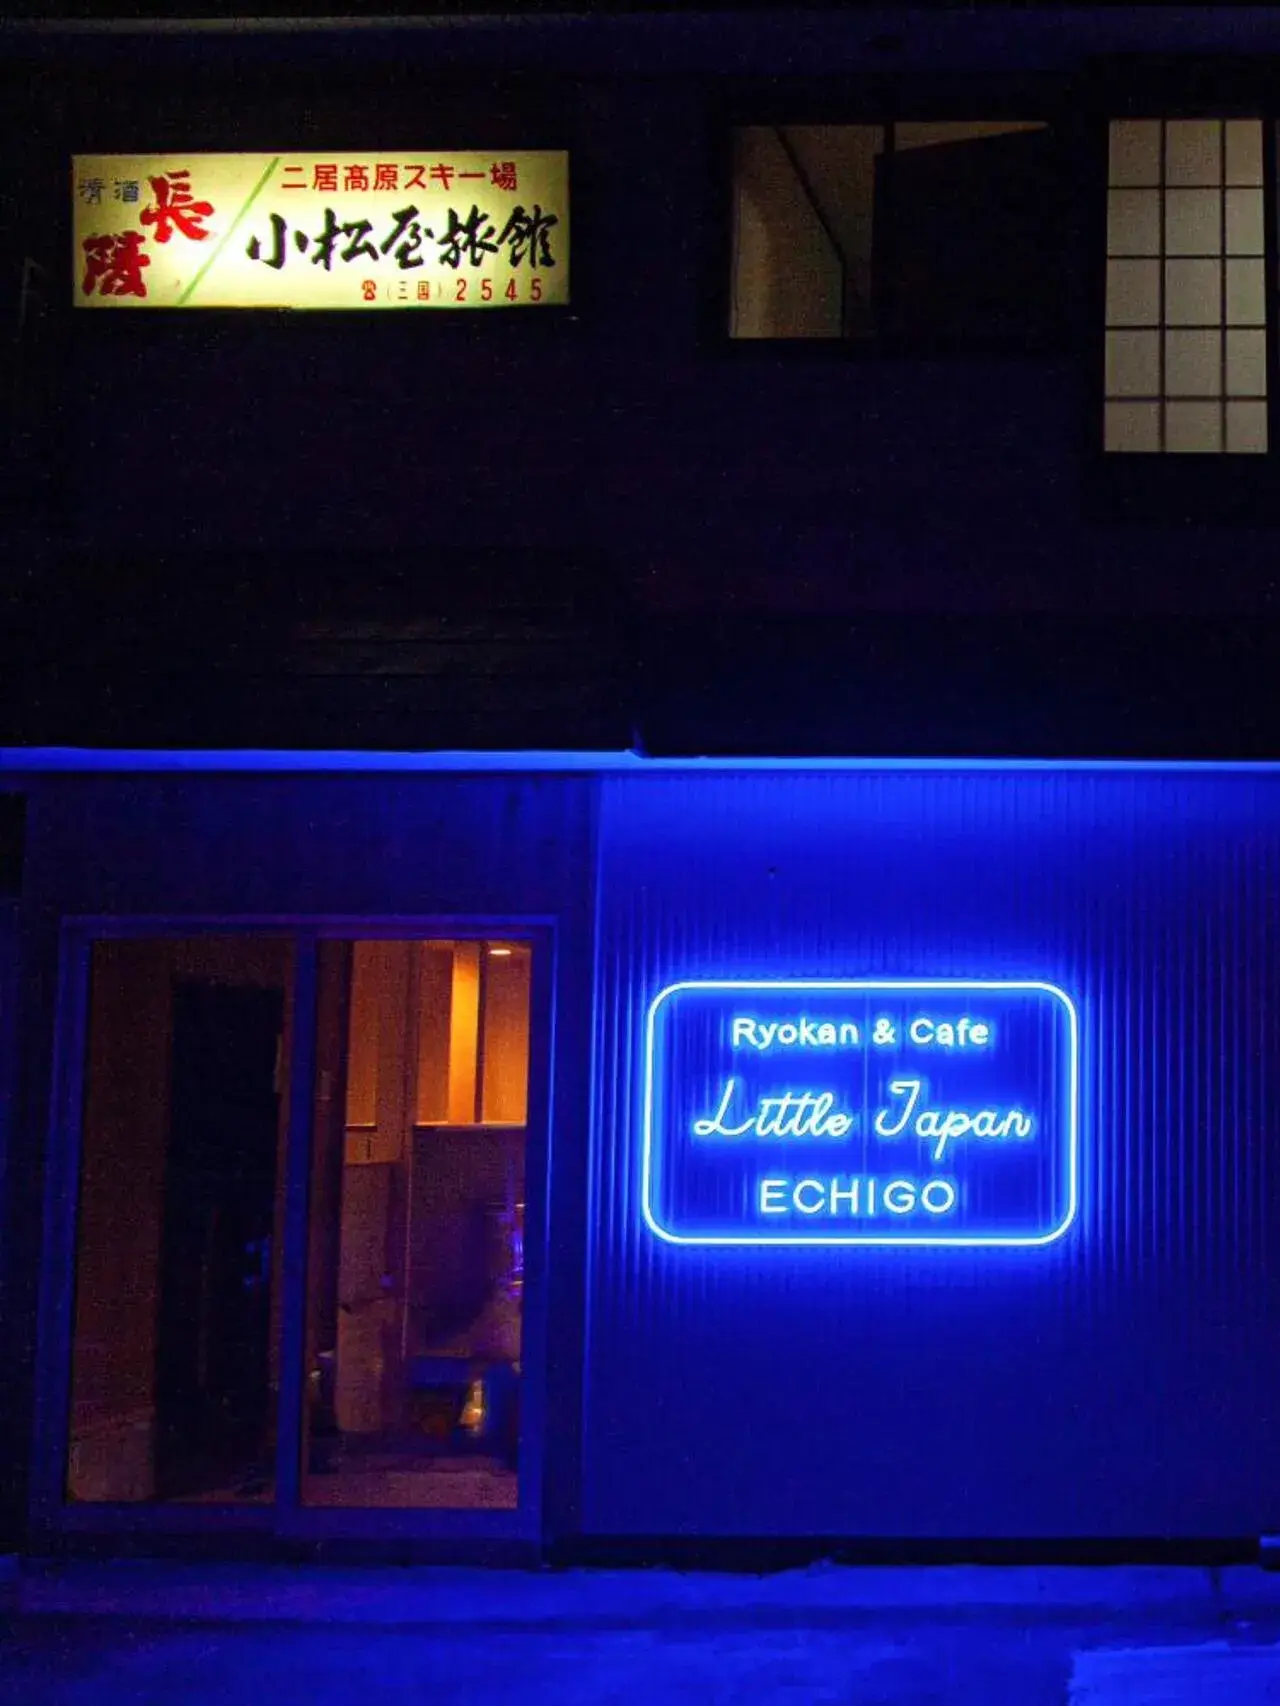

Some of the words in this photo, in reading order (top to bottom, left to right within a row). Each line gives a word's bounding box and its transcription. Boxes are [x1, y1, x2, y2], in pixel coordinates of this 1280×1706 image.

[246, 204, 560, 271] 小松屋旅館
[731, 1016, 861, 1049] Ryokan
[871, 1018, 897, 1044] &
[909, 1017, 991, 1047] Cafe
[692, 1079, 853, 1138] Little
[875, 1080, 1033, 1160] Japan
[760, 1178, 956, 1217] ECHIGO
